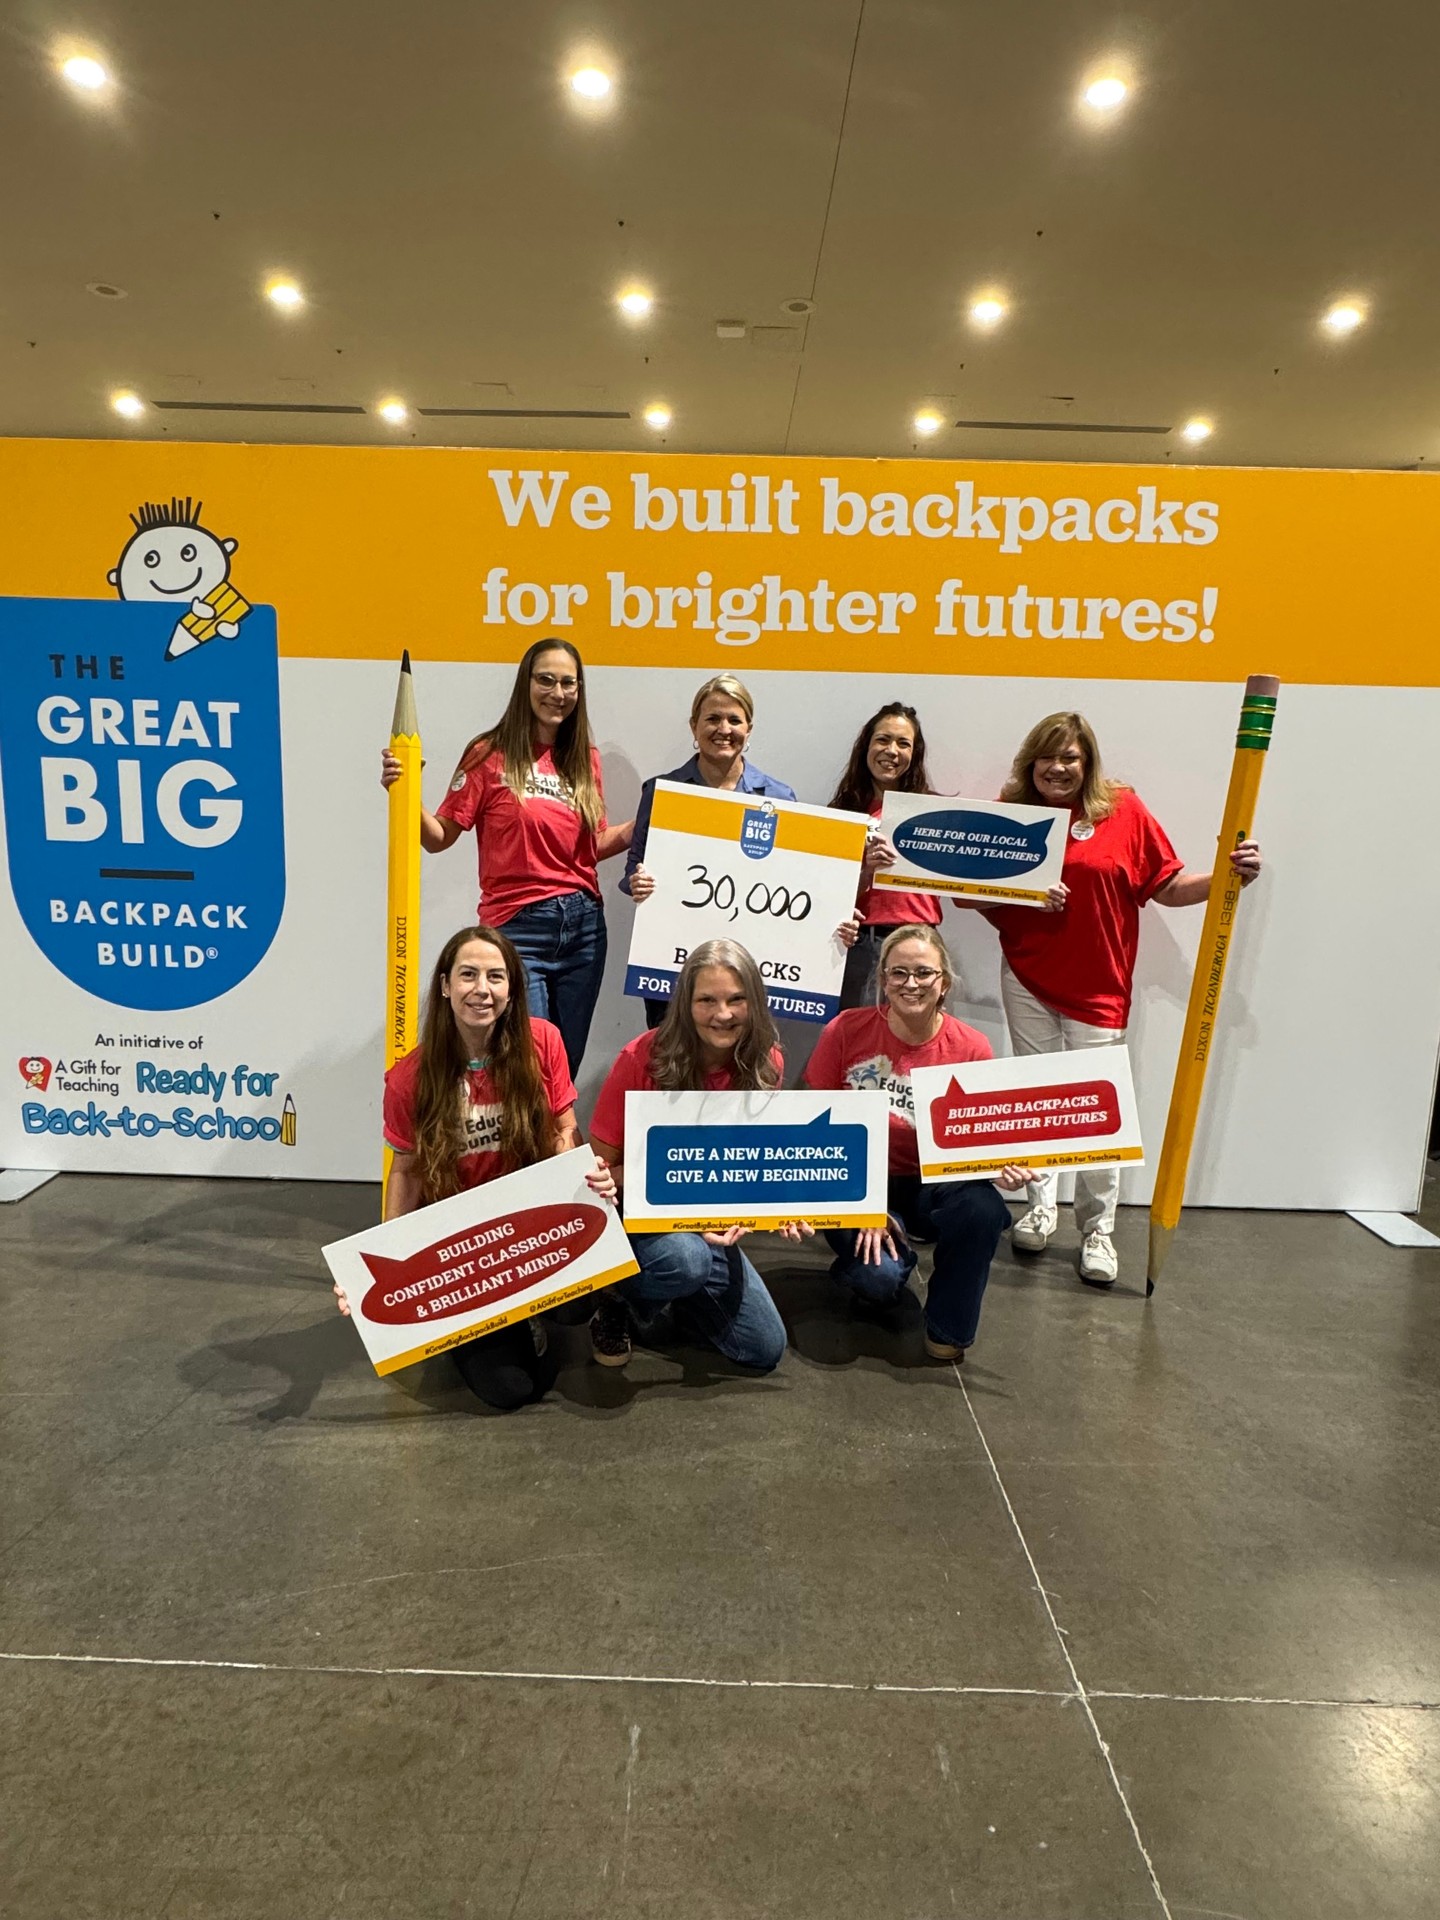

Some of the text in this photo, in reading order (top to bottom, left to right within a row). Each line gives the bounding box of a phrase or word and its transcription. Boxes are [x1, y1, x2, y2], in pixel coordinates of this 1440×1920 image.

[487, 469, 1220, 554] We built backpacks
[481, 566, 1219, 646] for brighter futures!
[49, 653, 125, 681] THE
[37, 695, 240, 749] GREAT
[40, 756, 244, 849] BIG
[745, 827, 771, 841] BIG
[747, 820, 772, 830] GREAT
[912, 826, 1028, 847] HERE FOR OUR LOCAL
[898, 839, 1041, 863] STUDENTS AND TEACHERS
[681, 864, 812, 922] 30,000
[49, 899, 248, 930] BACKPACK
[396, 916, 407, 959] DIXON
[637, 976, 671, 994] FOR
[1195, 1021, 1211, 1061] DIXON
[1203, 935, 1227, 1017] TICONDEROGA
[95, 1034, 204, 1050] An initiative of
[55, 1060, 122, 1076] A Gift for
[135, 1061, 280, 1102] Ready for
[56, 1077, 120, 1097] Teaching
[947, 1094, 1100, 1120] BUILDING BACKPACKS
[944, 1110, 1108, 1137] FOR BRIGHTER FUTURES
[667, 1146, 848, 1162] GIVE A NEW BACKPACK,
[1087, 1152, 1121, 1163] Teaching
[666, 1168, 849, 1183] GIVE A NEW BEGINNING
[436, 1222, 516, 1263] BUILDING
[383, 1218, 585, 1308] CONFIDENT CLASSROOMS
[416, 1247, 571, 1318] & BRILLIANT MINDS
